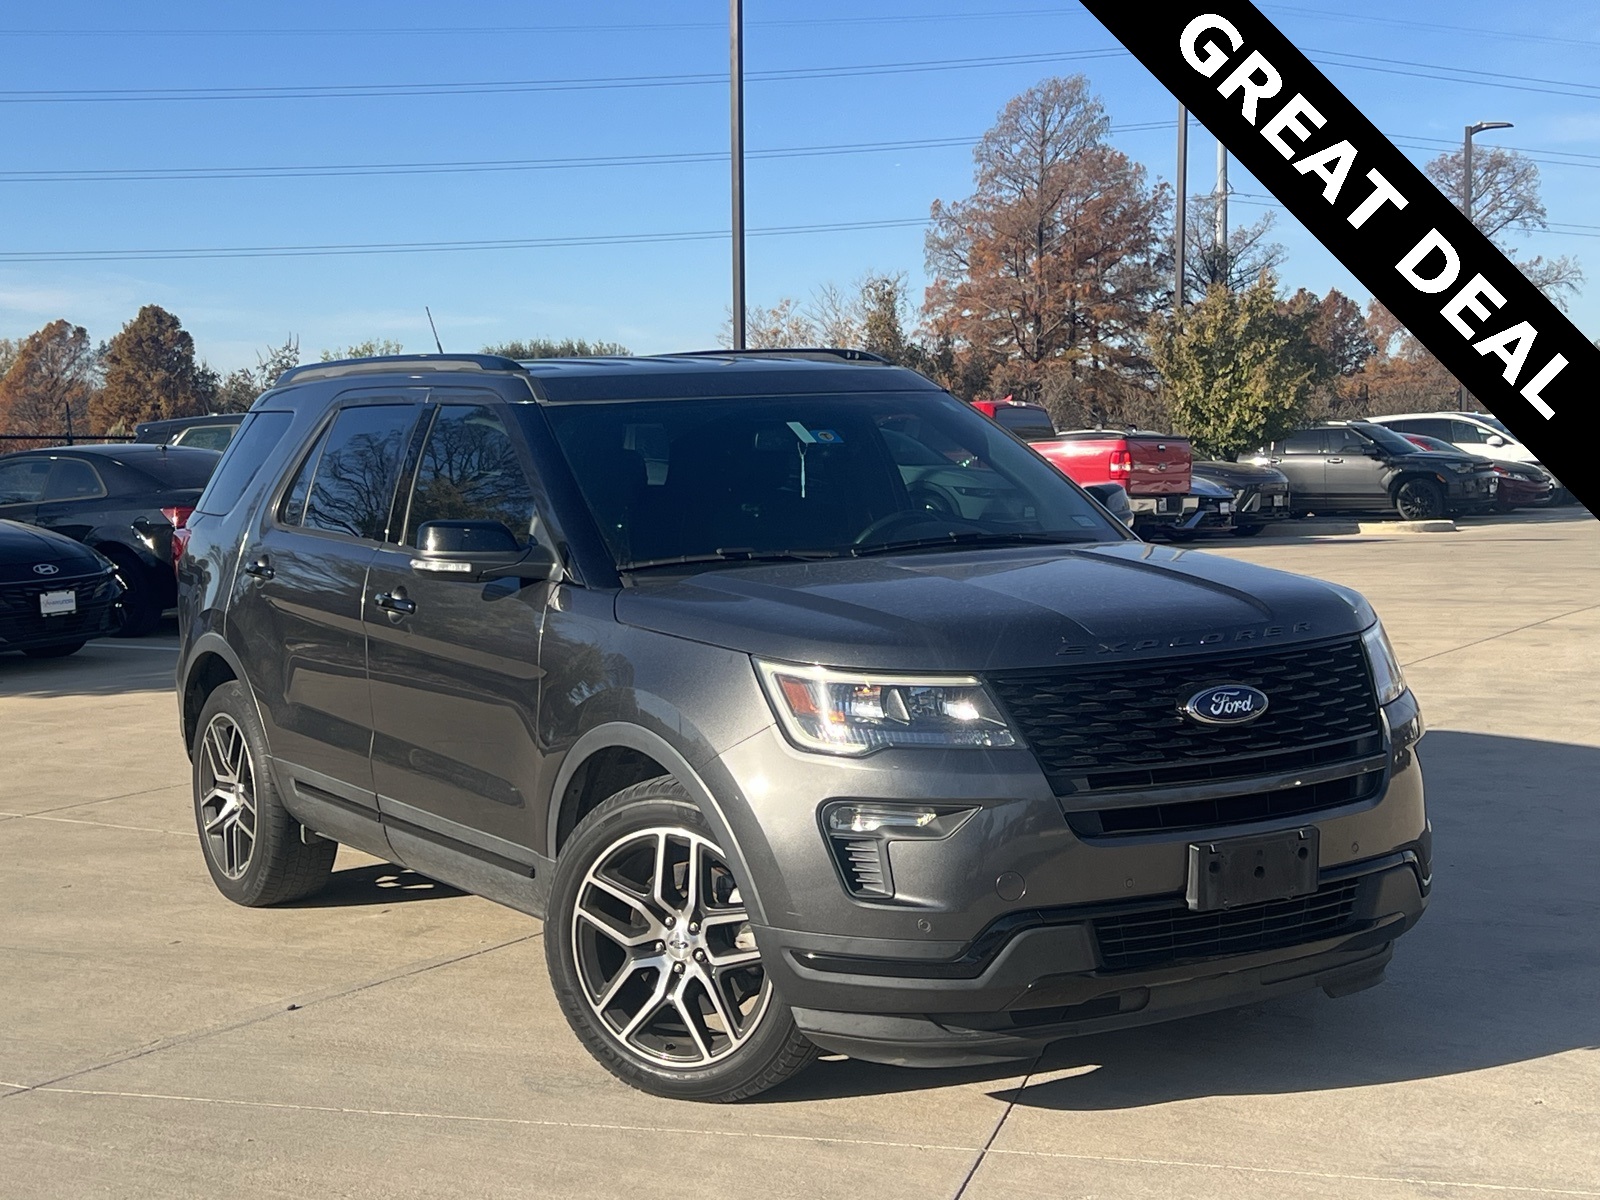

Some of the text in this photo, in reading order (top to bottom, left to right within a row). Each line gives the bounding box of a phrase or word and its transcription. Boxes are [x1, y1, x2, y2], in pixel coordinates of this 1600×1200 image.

[1056, 622, 1312, 656] EXPLORER
[1210, 691, 1254, 715] Ford
[563, 993, 639, 1077] MICHELIN
